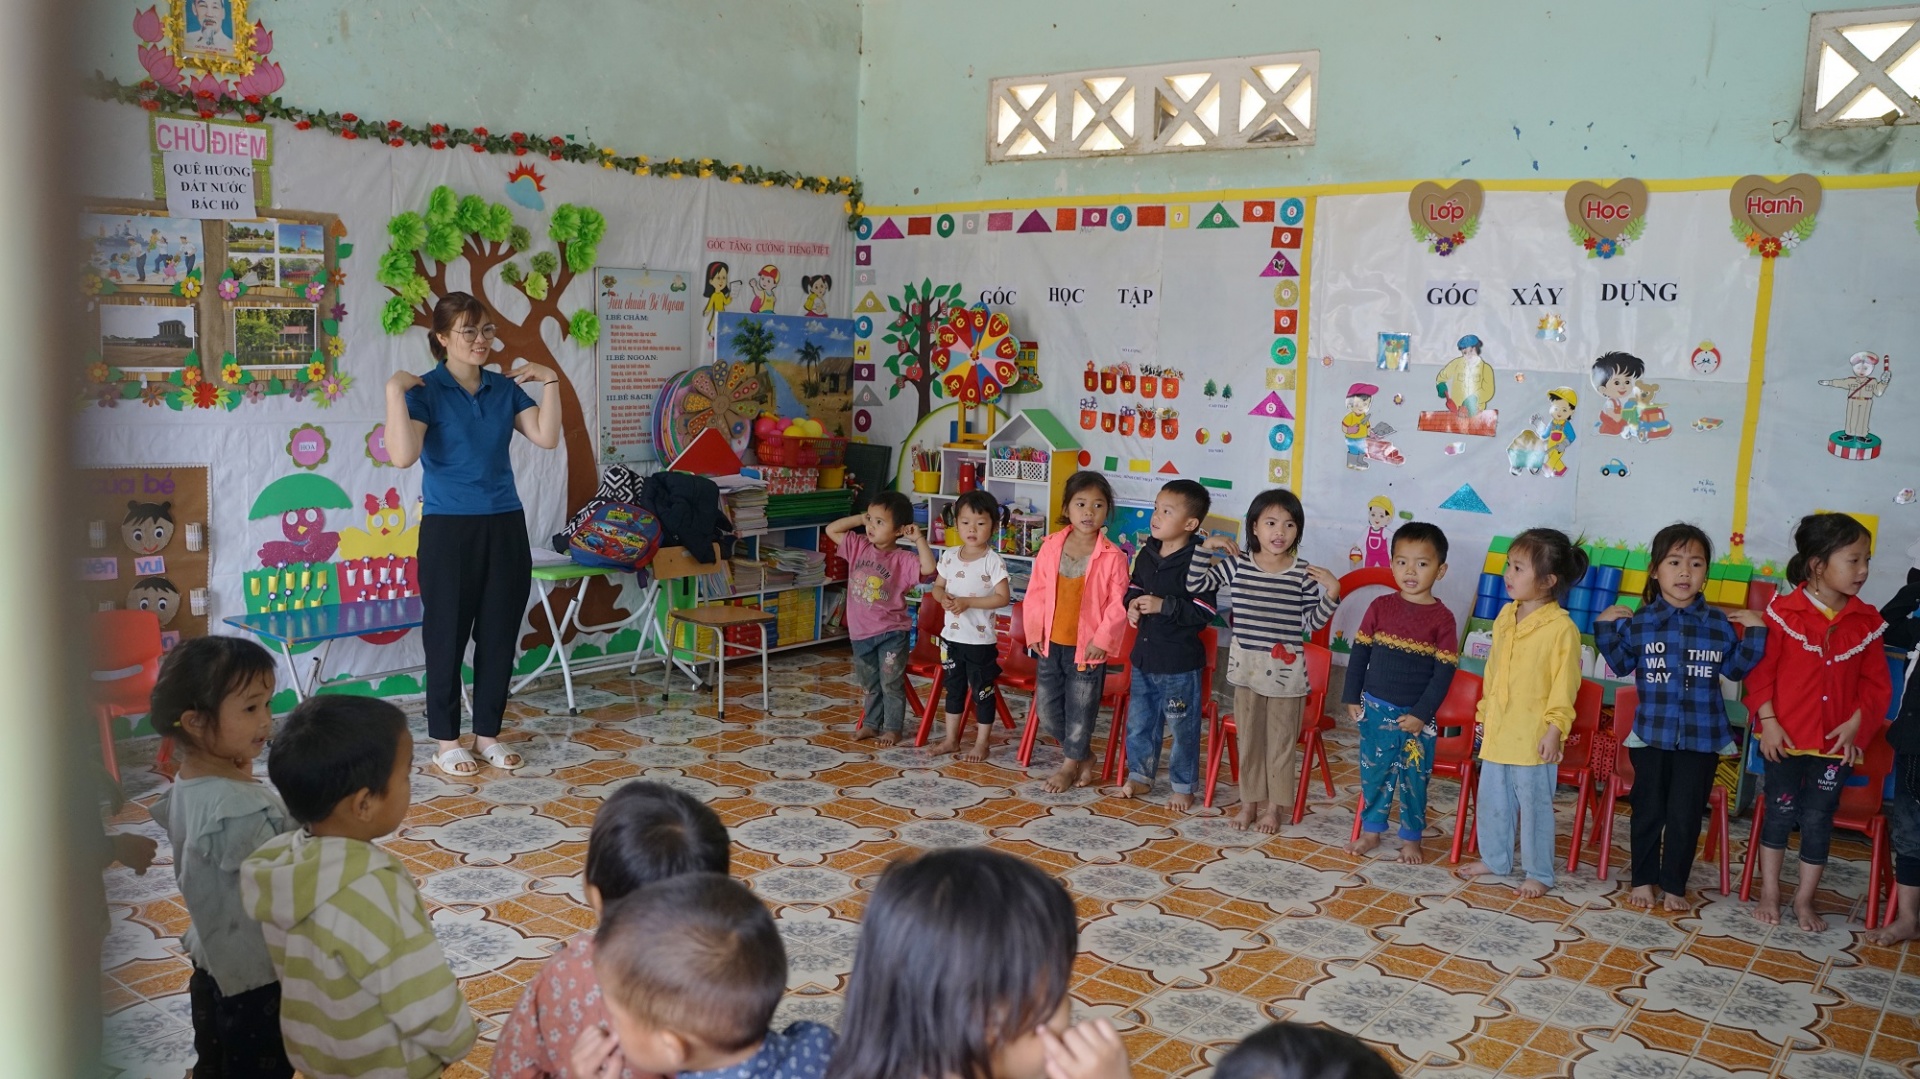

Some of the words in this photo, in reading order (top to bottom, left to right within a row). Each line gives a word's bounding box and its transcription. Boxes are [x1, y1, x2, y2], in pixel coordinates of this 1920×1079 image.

[157, 122, 206, 153] CHỦ
[173, 162, 201, 176] QUÊ
[205, 165, 251, 177] HƯƠNG
[211, 181, 247, 193] NƯỚC
[191, 197, 217, 210] BÁC
[1747, 196, 1803, 217] Hạnh
[1430, 199, 1464, 223] Lớp
[1586, 201, 1630, 223] Học
[707, 238, 726, 250] GÓC
[980, 287, 1017, 305] GÓC
[1049, 287, 1085, 306] HỌC
[1118, 287, 1153, 308] TẬP
[1427, 283, 1478, 305] GÓC
[1511, 282, 1563, 305] XÂY
[1601, 280, 1678, 306] DỰNG
[956, 318, 965, 328] e
[967, 388, 976, 398] o
[301, 443, 316, 451] HOA
[143, 471, 175, 494] bé
[137, 557, 163, 574] vui
[1645, 642, 1666, 654] NO
[1645, 657, 1666, 669] WA
[1687, 649, 1723, 663] THIN
[1645, 672, 1672, 684] SAY
[1686, 664, 1713, 678] THE
[1817, 778, 1838, 787] HAPPY
